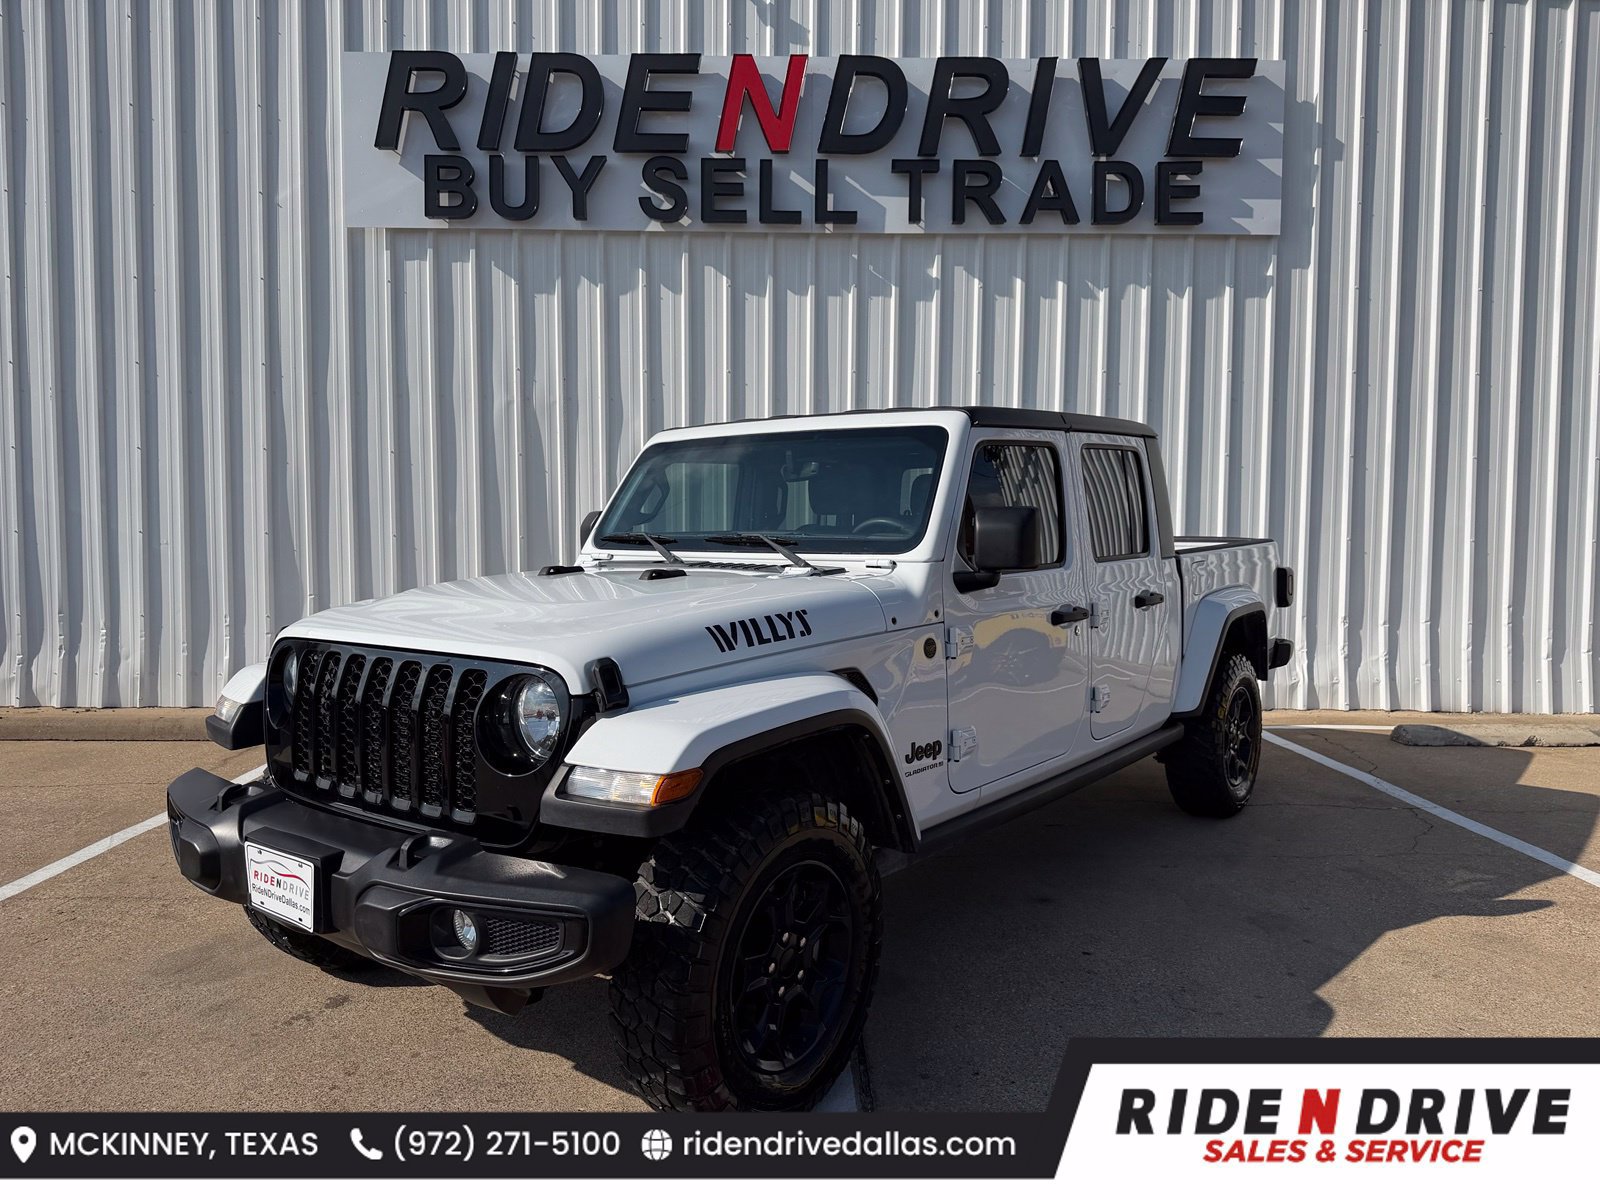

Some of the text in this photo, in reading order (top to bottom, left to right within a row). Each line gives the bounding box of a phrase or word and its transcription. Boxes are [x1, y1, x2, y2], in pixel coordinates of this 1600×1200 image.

[424, 154, 1204, 226] BUY SELL TRADE
[705, 609, 812, 653] WILLYS
[905, 740, 943, 764] Jeep
[904, 763, 938, 778] GLADIATOR
[251, 883, 311, 915] RideNDriveDallas.com
[253, 870, 310, 901] RIDENDRIVE
